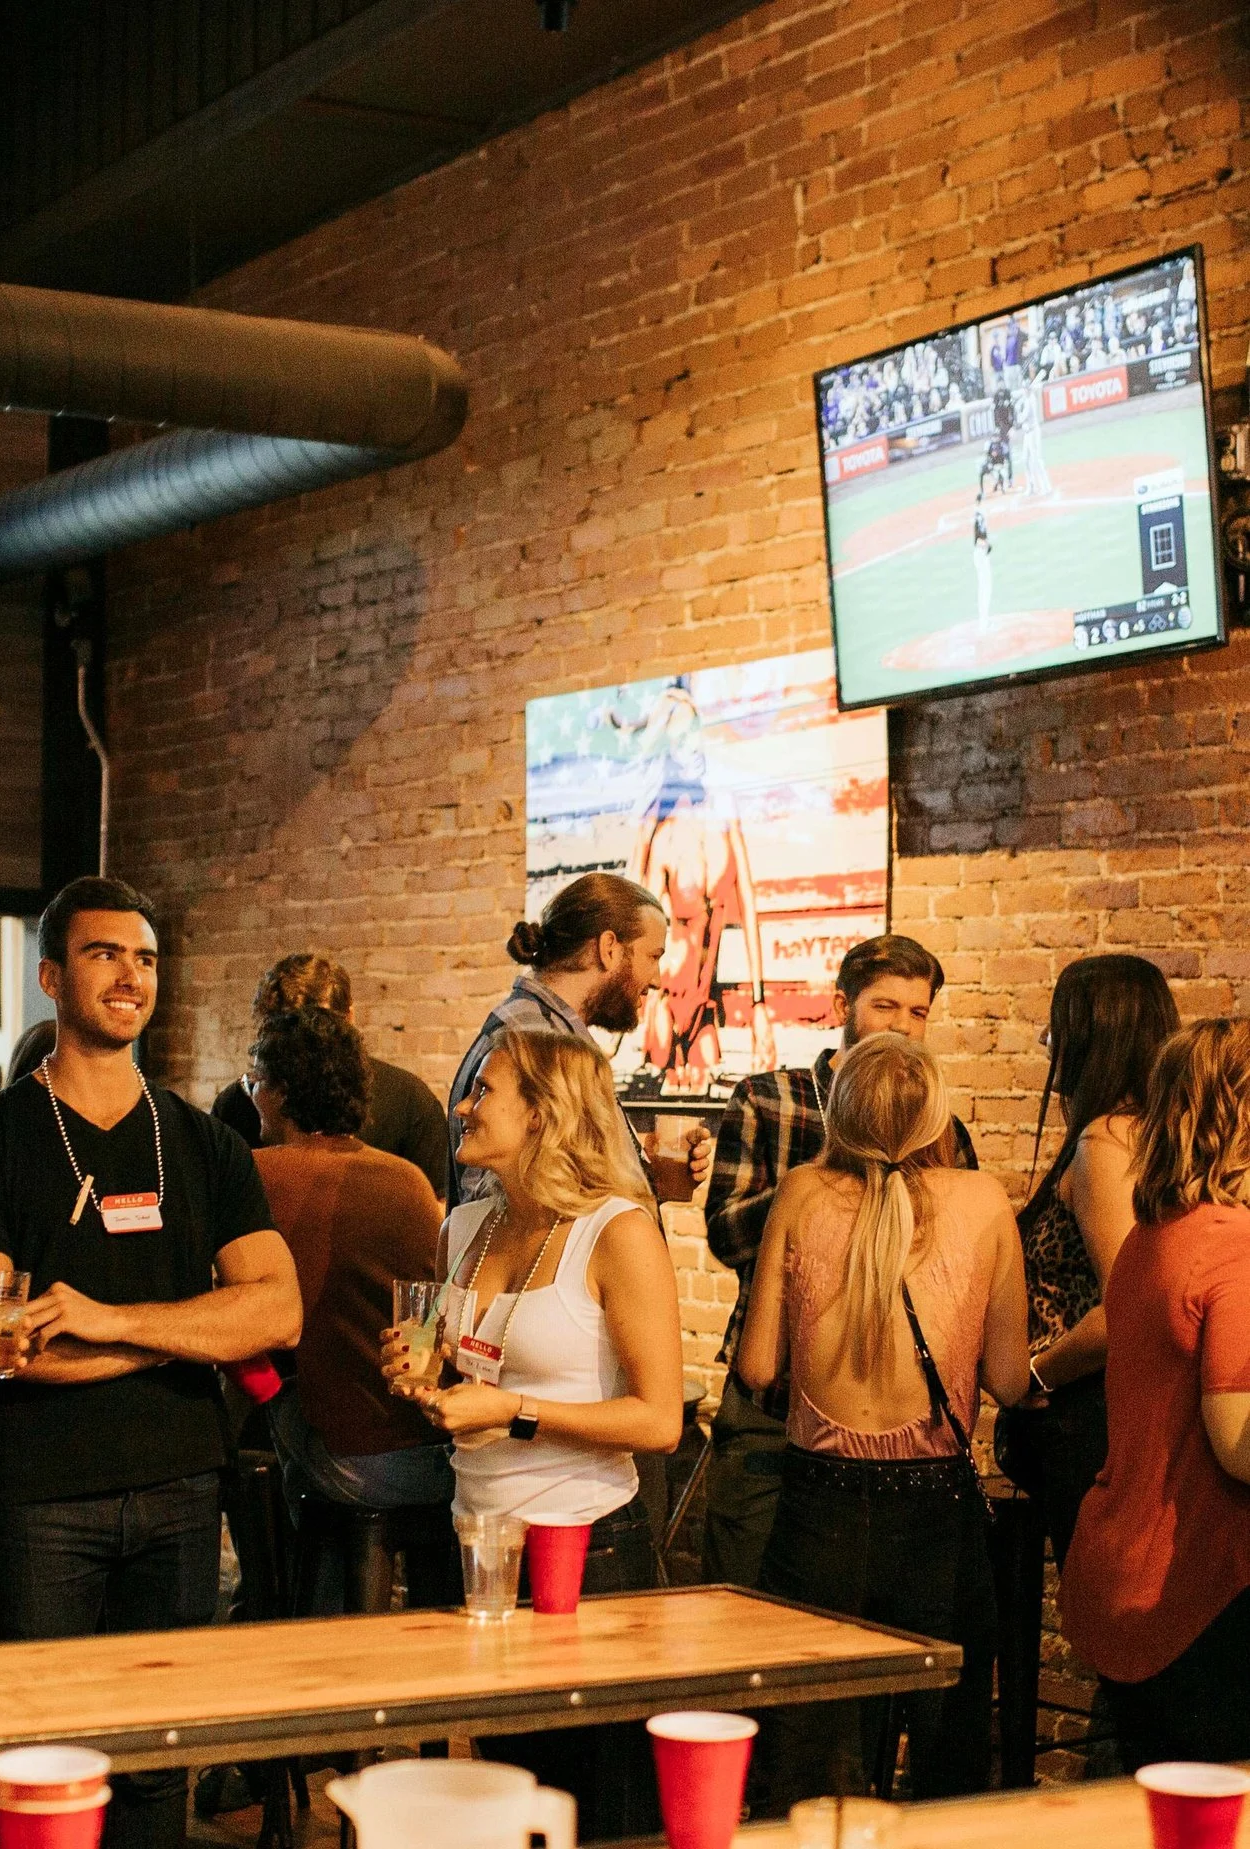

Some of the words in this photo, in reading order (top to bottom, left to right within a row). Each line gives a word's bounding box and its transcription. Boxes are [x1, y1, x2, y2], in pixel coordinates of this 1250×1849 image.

[1070, 377, 1123, 406] TOYOTA
[841, 446, 885, 472] TOYOTA
[114, 1196, 143, 1205] HELLO
[470, 1340, 492, 1353] HELLO
